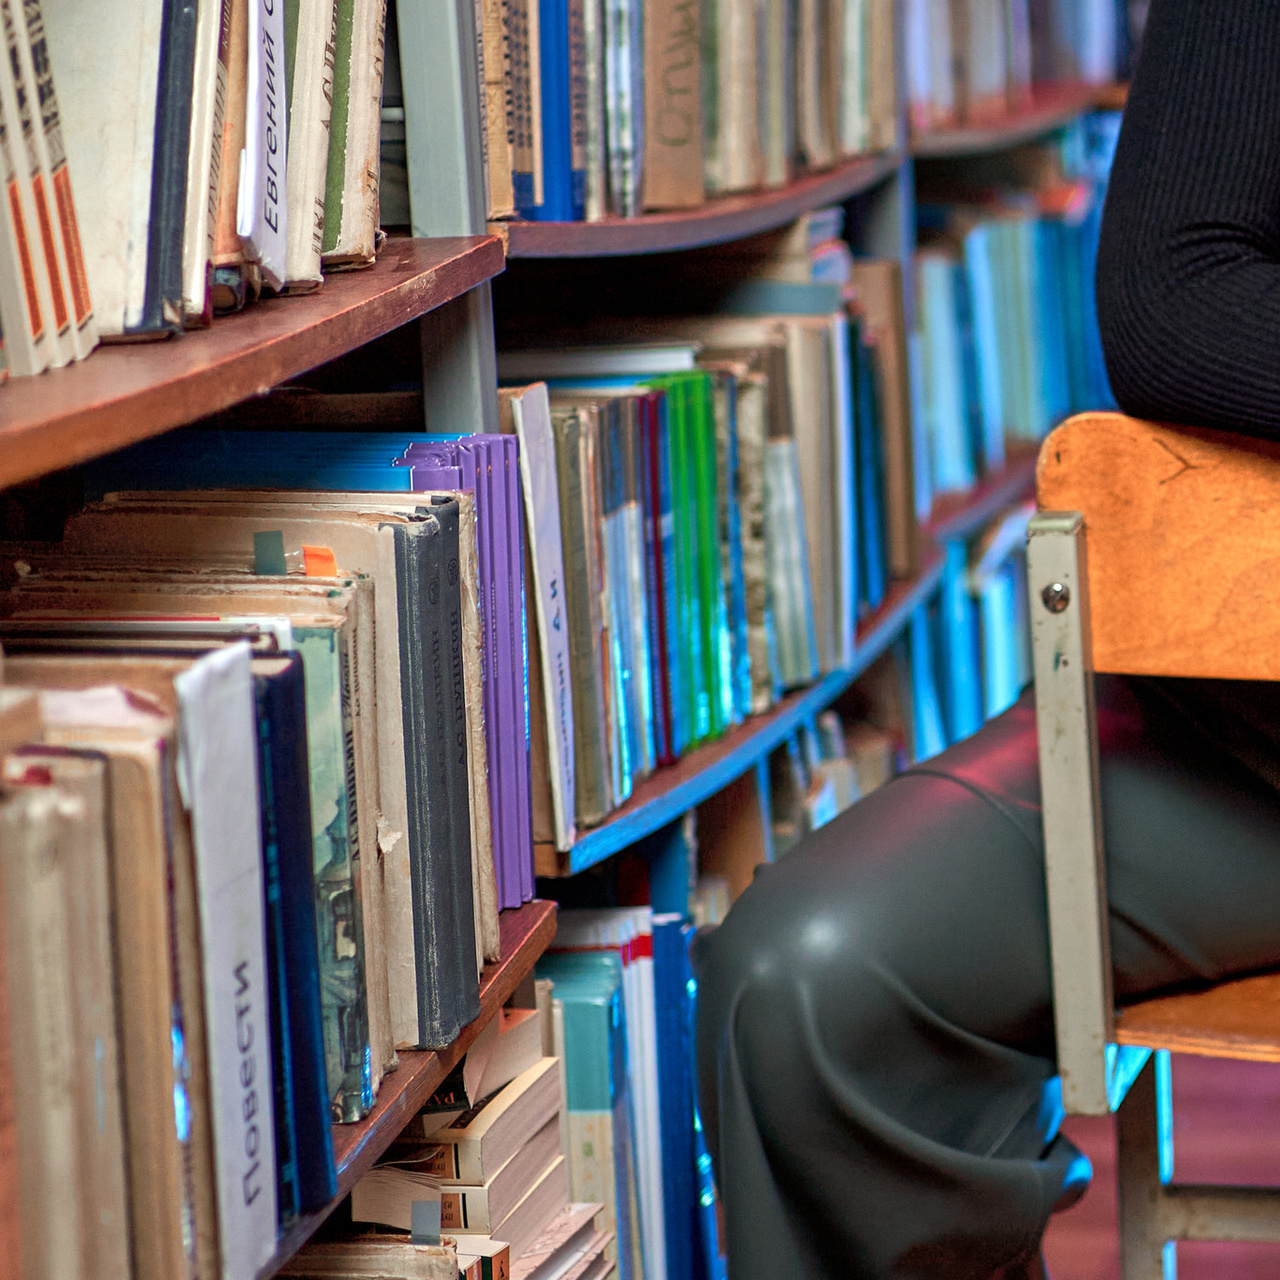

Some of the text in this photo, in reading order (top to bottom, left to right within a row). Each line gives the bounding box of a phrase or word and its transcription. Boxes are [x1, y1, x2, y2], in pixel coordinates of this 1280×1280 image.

[207, 70, 226, 218] ПУШКИН
[261, 25, 280, 235] Евгений
[431, 627, 444, 742] ПУШКИН
[450, 608, 463, 722] ПУШКИН
[345, 729, 358, 827] ПУШКИН
[232, 960, 262, 1208] Повести
